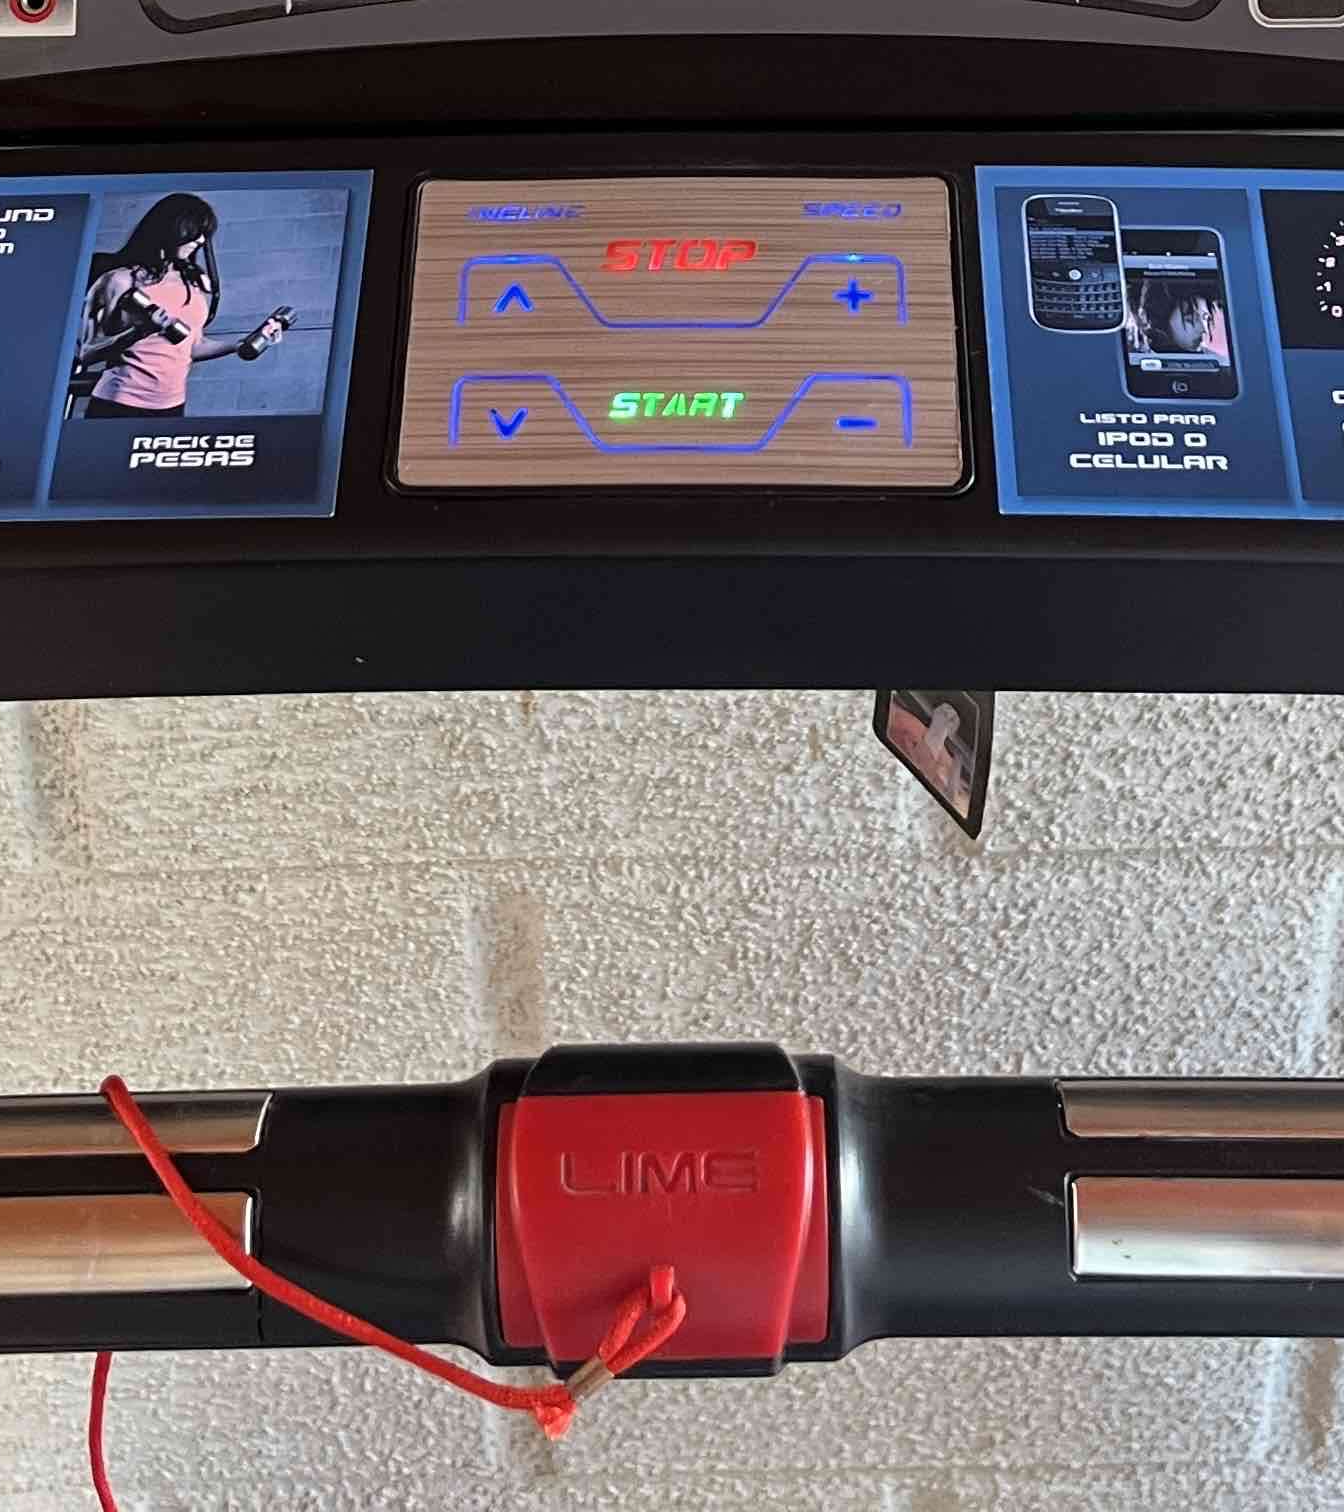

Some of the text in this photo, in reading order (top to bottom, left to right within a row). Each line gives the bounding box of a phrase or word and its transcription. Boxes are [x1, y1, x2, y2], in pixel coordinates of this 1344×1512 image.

[801, 202, 902, 219] SPEED
[599, 239, 758, 272] STOP
[1324, 281, 1332, 292] 1
[1331, 305, 1343, 318] 0
[607, 391, 746, 419] START
[1080, 413, 1217, 426] LISTO PARA
[132, 434, 255, 450] RACK DE
[1097, 431, 1208, 448] IPOD O
[129, 450, 256, 469] PESAS
[1069, 453, 1229, 472] CELULAR
[559, 1149, 760, 1197] LIME
